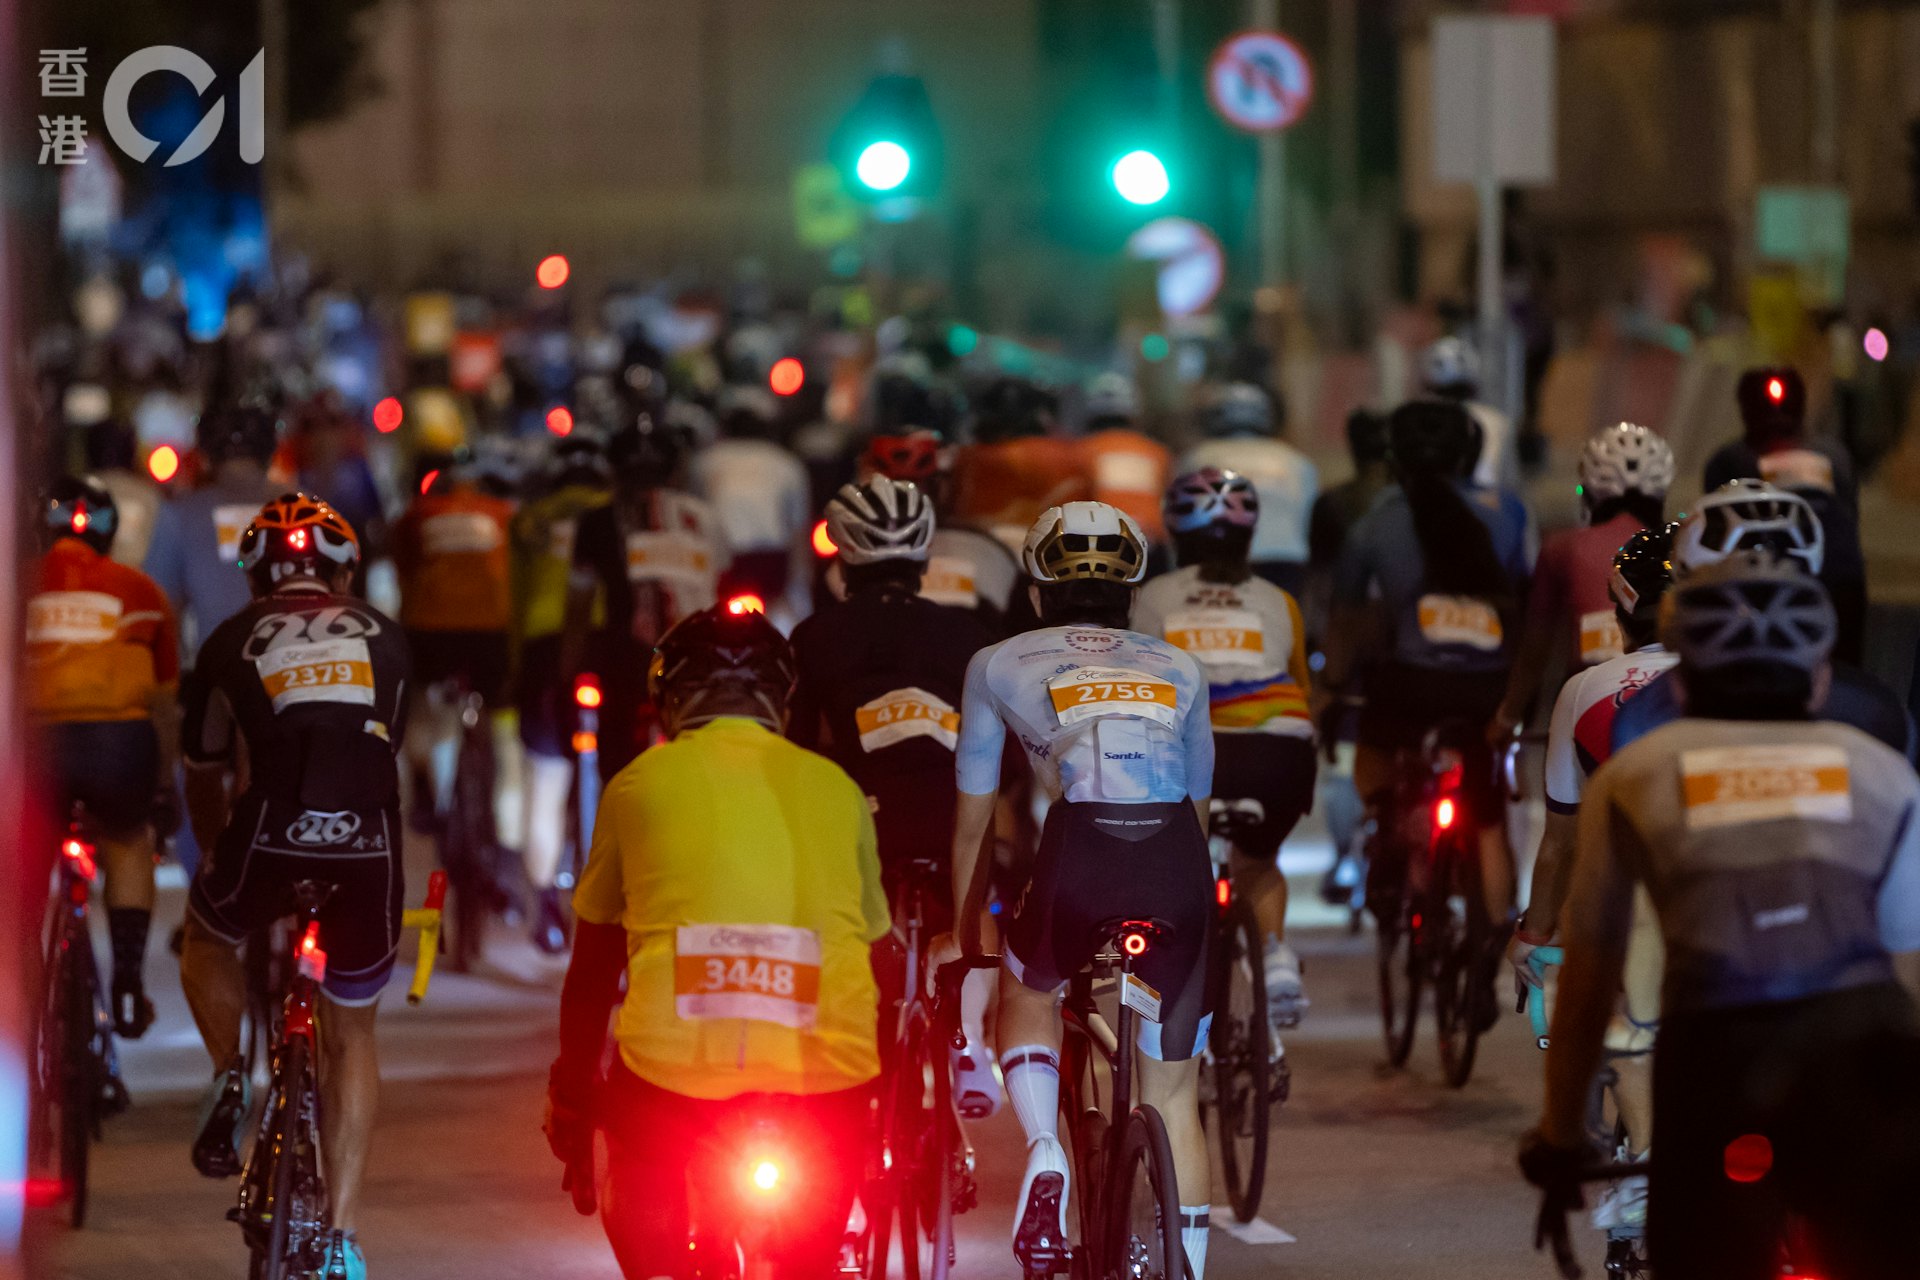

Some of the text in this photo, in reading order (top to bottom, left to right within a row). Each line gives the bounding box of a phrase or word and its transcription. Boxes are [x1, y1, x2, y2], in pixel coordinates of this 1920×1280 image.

[282, 663, 353, 688] 2379
[1076, 683, 1155, 702] 2756
[1021, 734, 1051, 761] Santic
[1103, 751, 1146, 760] Santic
[704, 957, 795, 995] 3448
